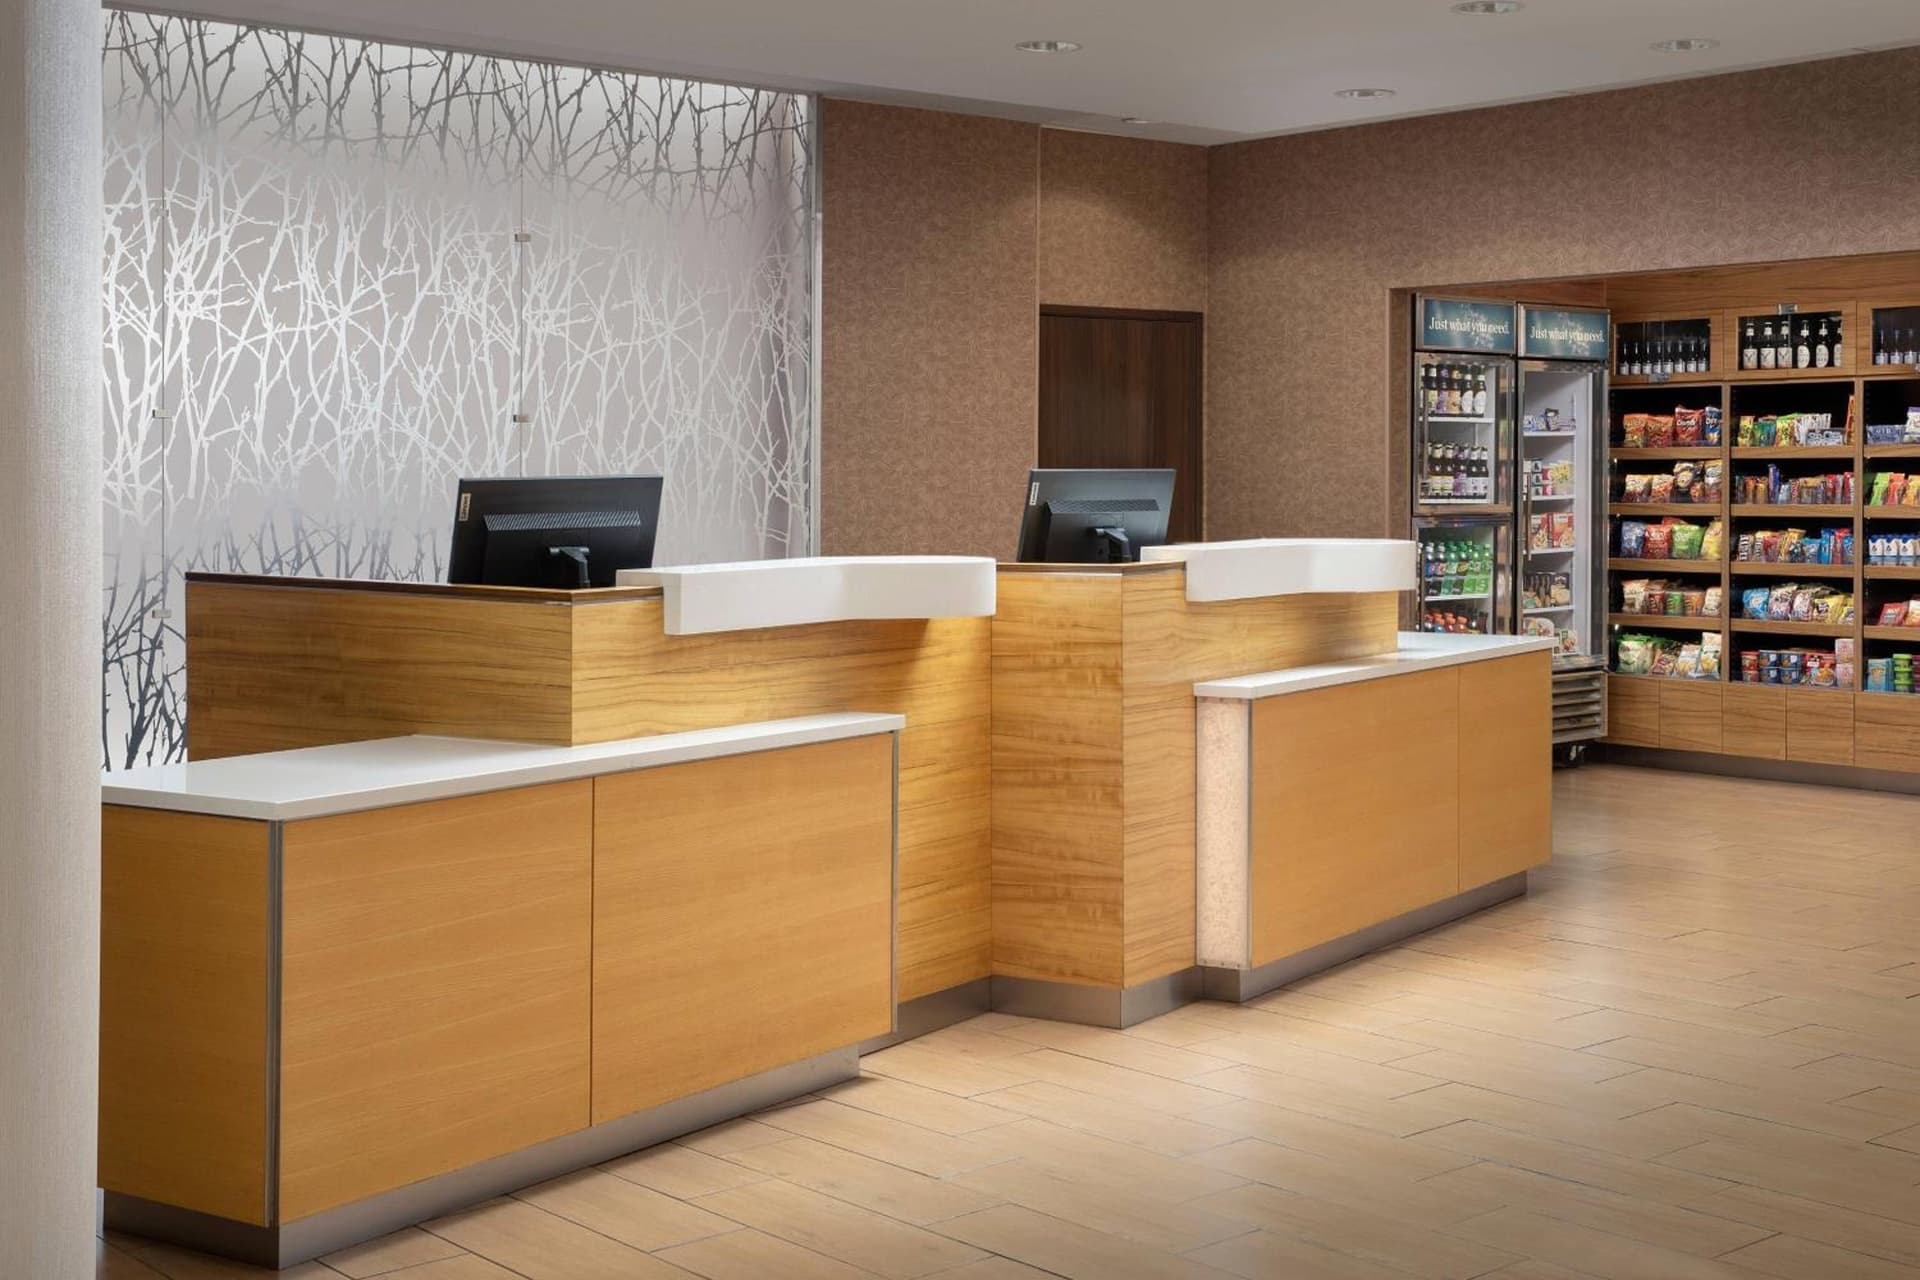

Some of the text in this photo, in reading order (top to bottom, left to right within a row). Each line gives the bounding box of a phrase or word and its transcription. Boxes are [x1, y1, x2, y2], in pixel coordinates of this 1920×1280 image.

[1429, 317, 1448, 331] Just
[1449, 318, 1471, 332] what
[1530, 326, 1547, 339] Just
